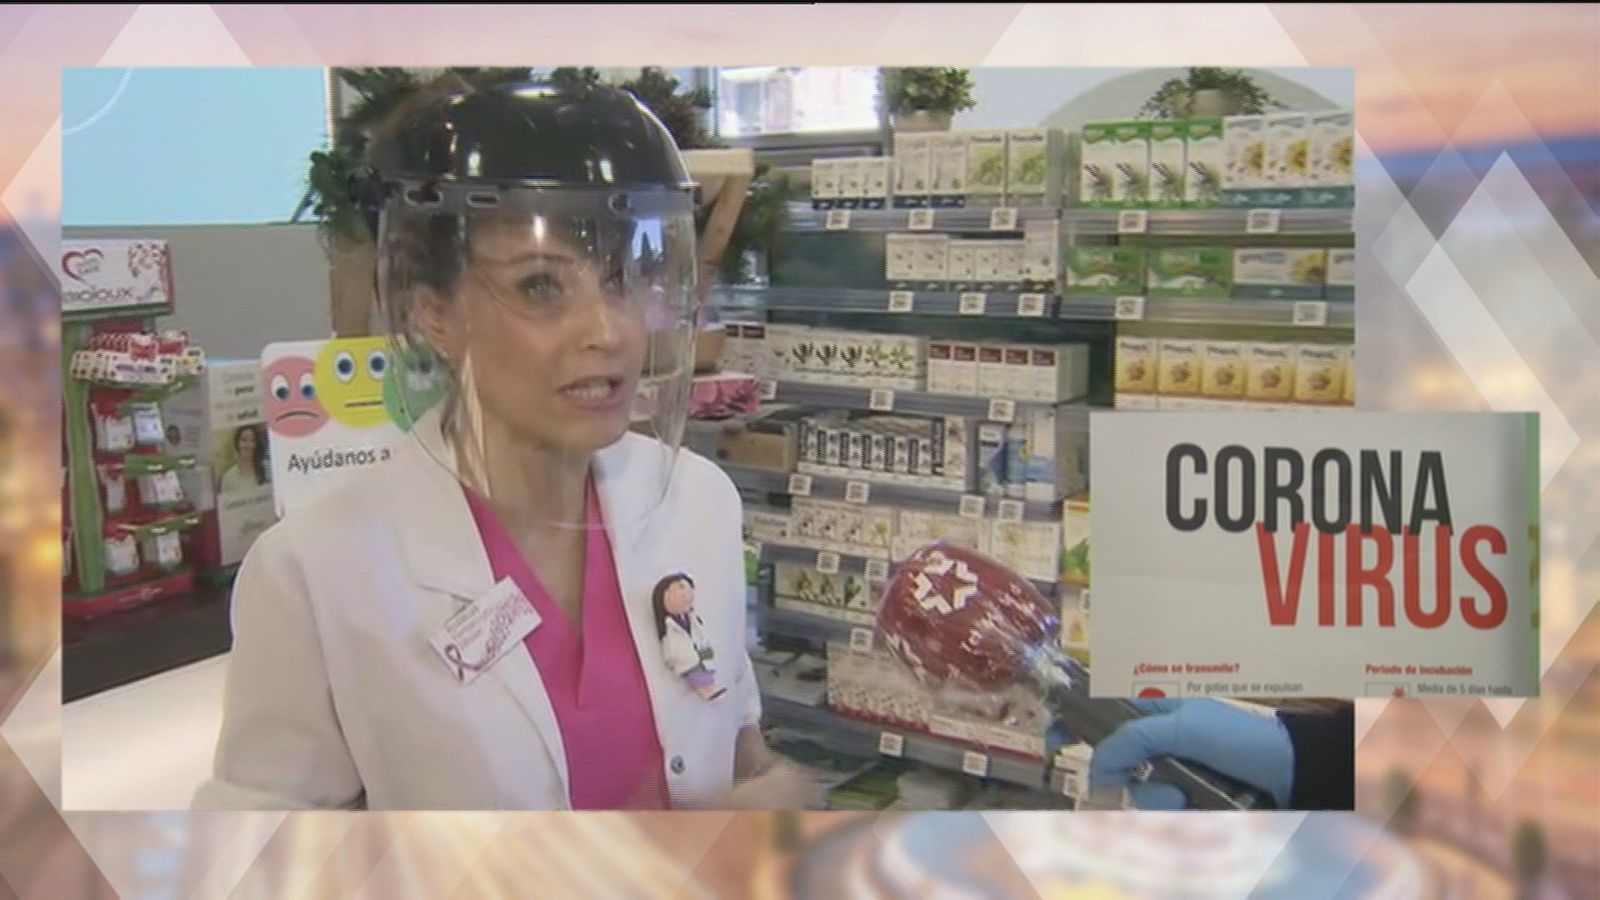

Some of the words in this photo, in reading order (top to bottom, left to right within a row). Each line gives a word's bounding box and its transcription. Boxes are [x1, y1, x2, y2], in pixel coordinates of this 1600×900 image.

[287, 448, 376, 475] Ayúdanos
[1166, 443, 1453, 536] CORONA
[1256, 521, 1508, 630] VIRUS
[1133, 662, 1168, 676] ¿Cómo
[1171, 665, 1183, 674] se
[1186, 663, 1240, 674] transmite?
[1405, 665, 1416, 675] de
[1187, 682, 1202, 692] Por
[1204, 682, 1228, 694] gotas
[1231, 684, 1248, 694] que
[1250, 684, 1261, 693] se
[1263, 681, 1304, 694] expulsan
[1417, 683, 1445, 695] Media
[1446, 684, 1458, 695] de
[1460, 684, 1465, 695] 5
